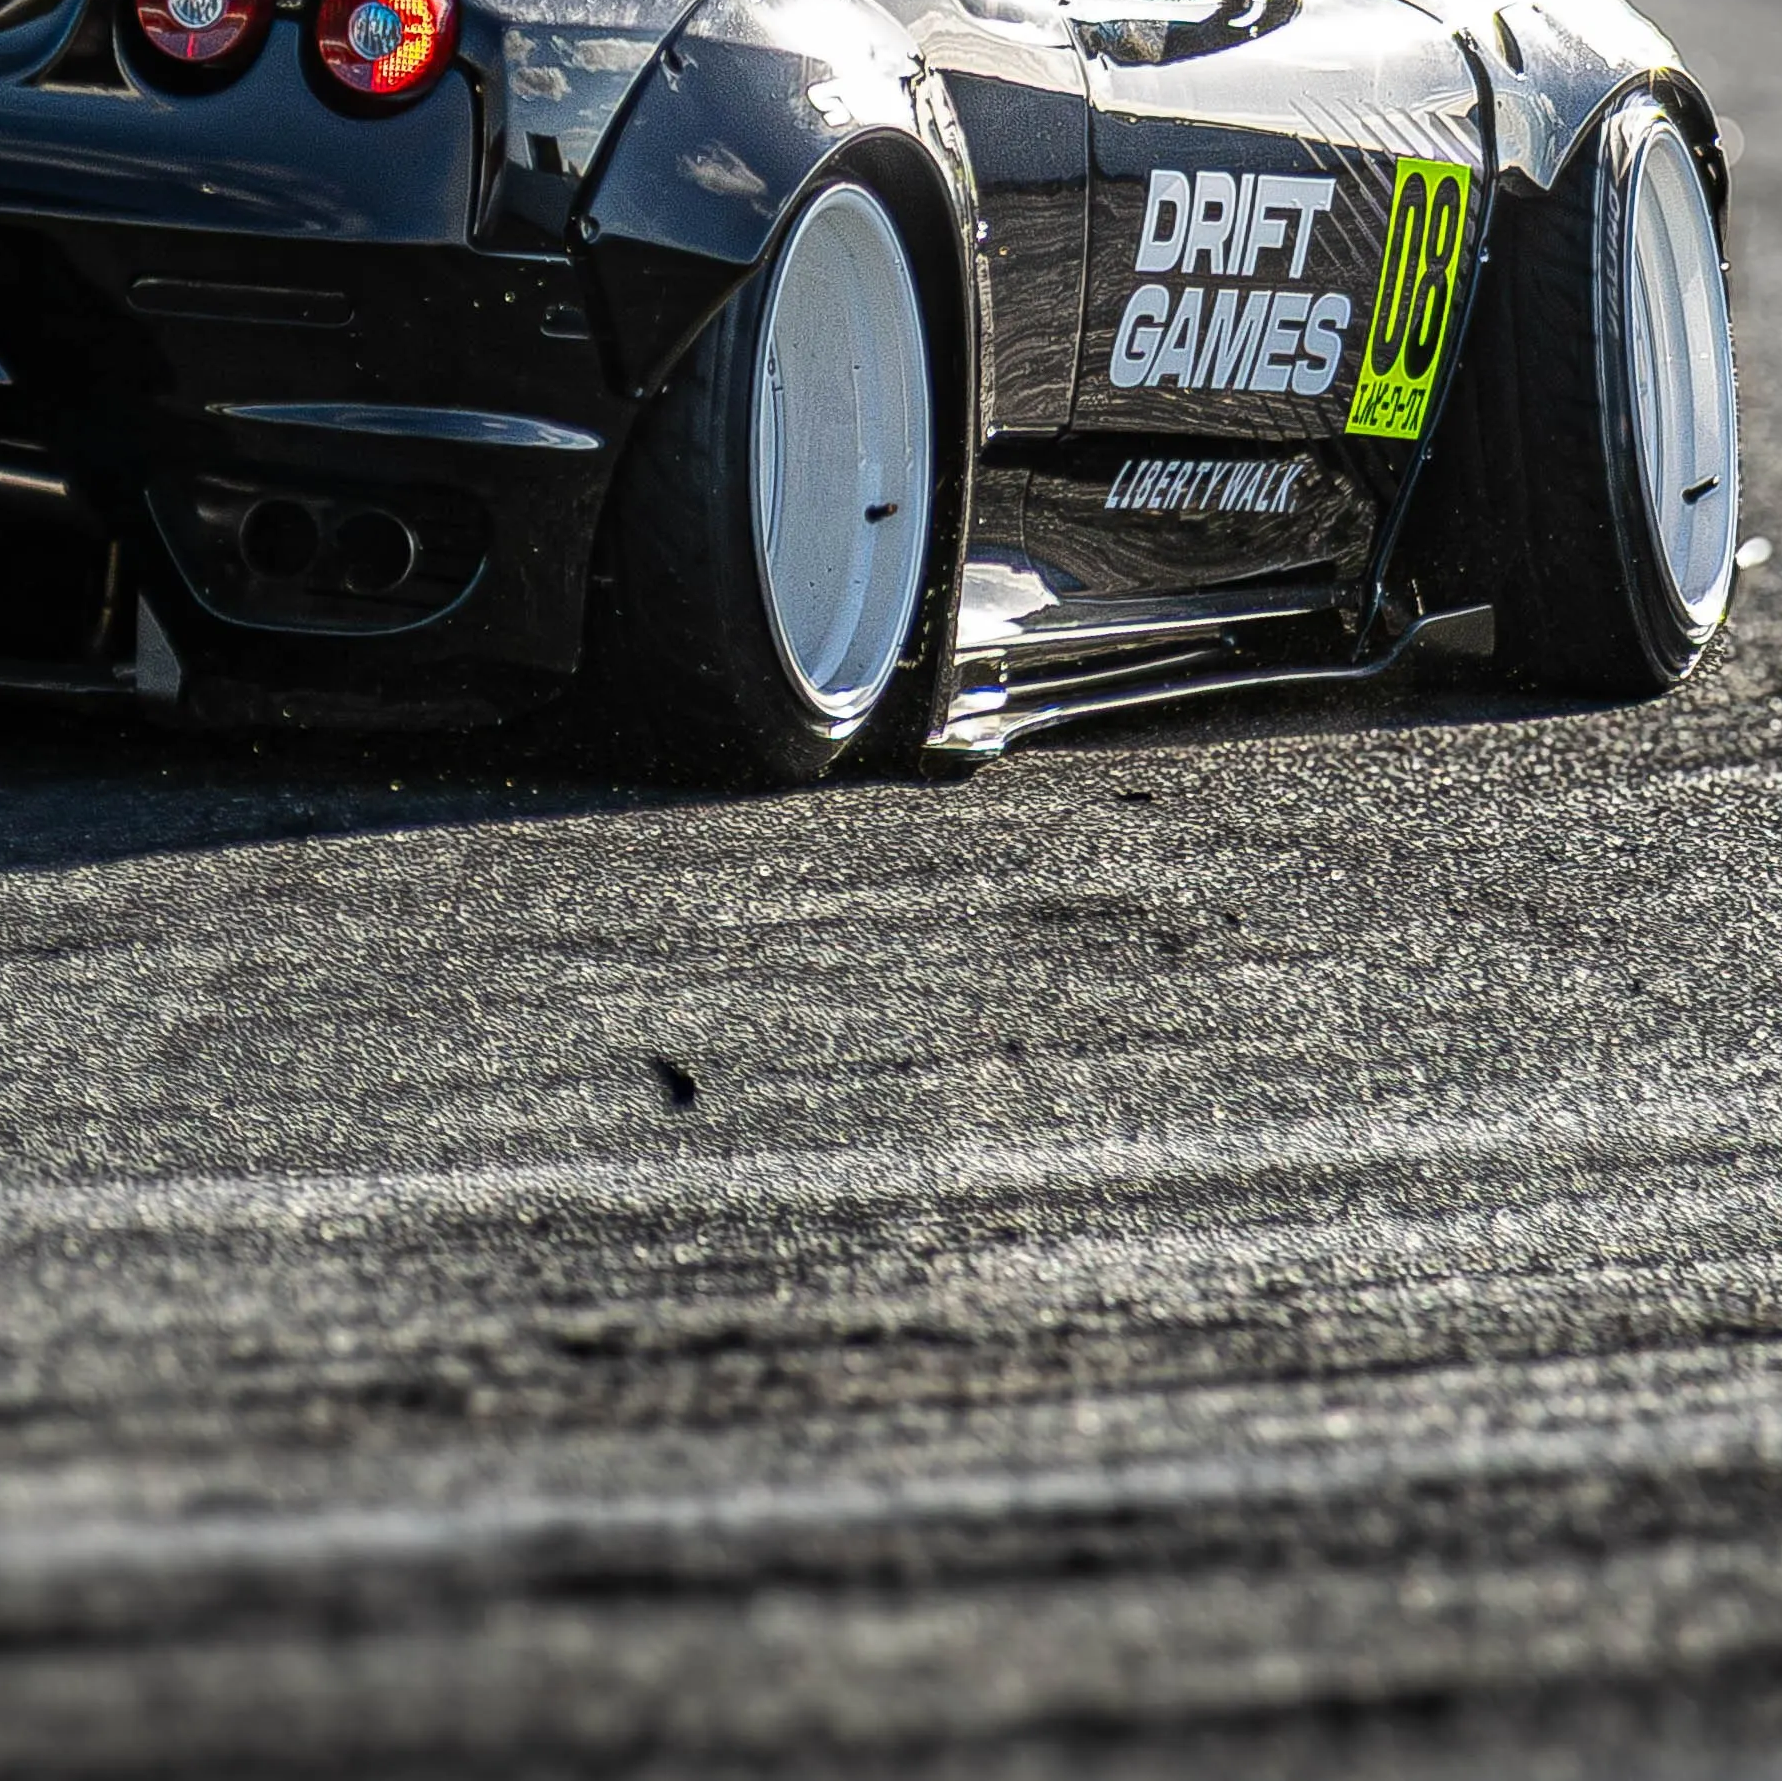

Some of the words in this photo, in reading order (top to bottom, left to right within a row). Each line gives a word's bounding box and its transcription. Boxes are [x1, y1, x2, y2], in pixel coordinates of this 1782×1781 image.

[1134, 168, 1337, 279] DRIFT
[1370, 171, 1461, 380] 08
[1109, 284, 1352, 395] GAMES
